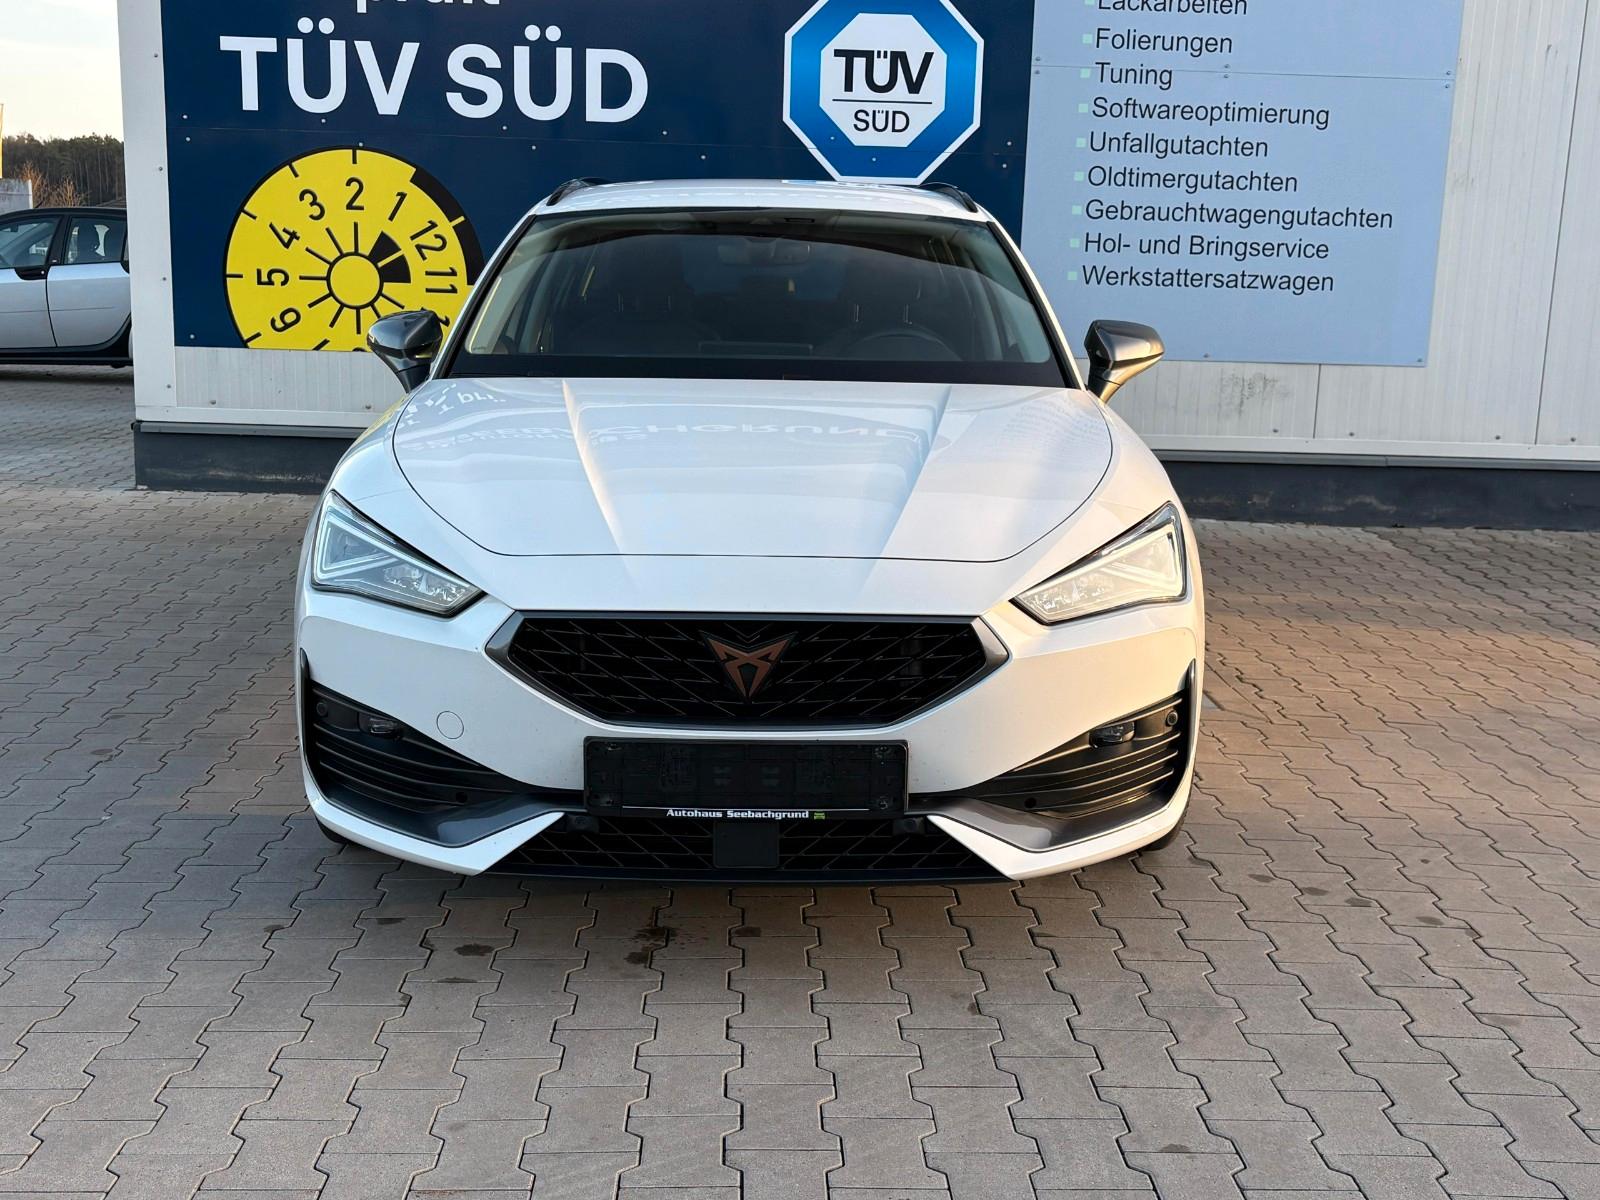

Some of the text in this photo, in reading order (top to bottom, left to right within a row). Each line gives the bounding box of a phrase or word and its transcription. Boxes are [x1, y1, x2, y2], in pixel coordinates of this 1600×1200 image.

[1095, 27, 1233, 57] Folierungen
[220, 17, 648, 123] TÜV SÜD
[833, 49, 934, 95] TÜV
[1095, 62, 1173, 91] Tuning
[853, 109, 910, 133] SÜD
[1092, 97, 1330, 130] Softwareoptimierung
[1090, 131, 1268, 159] Unfallgutachten
[345, 177, 365, 210] 2
[1087, 166, 1298, 195] Oldtimergutachten
[299, 188, 326, 221] 3
[388, 191, 407, 221] 1
[1085, 199, 1393, 231] Gebrauchtwagengutachten
[269, 222, 301, 250] 4
[410, 219, 447, 261] 12
[1084, 232, 1329, 262] Hol- und Bringservice
[257, 268, 290, 287] 5
[425, 266, 458, 294] 11
[1083, 265, 1334, 296] Werkstattersatzwagen
[666, 809, 809, 821] Autohaus Seebachgrund
